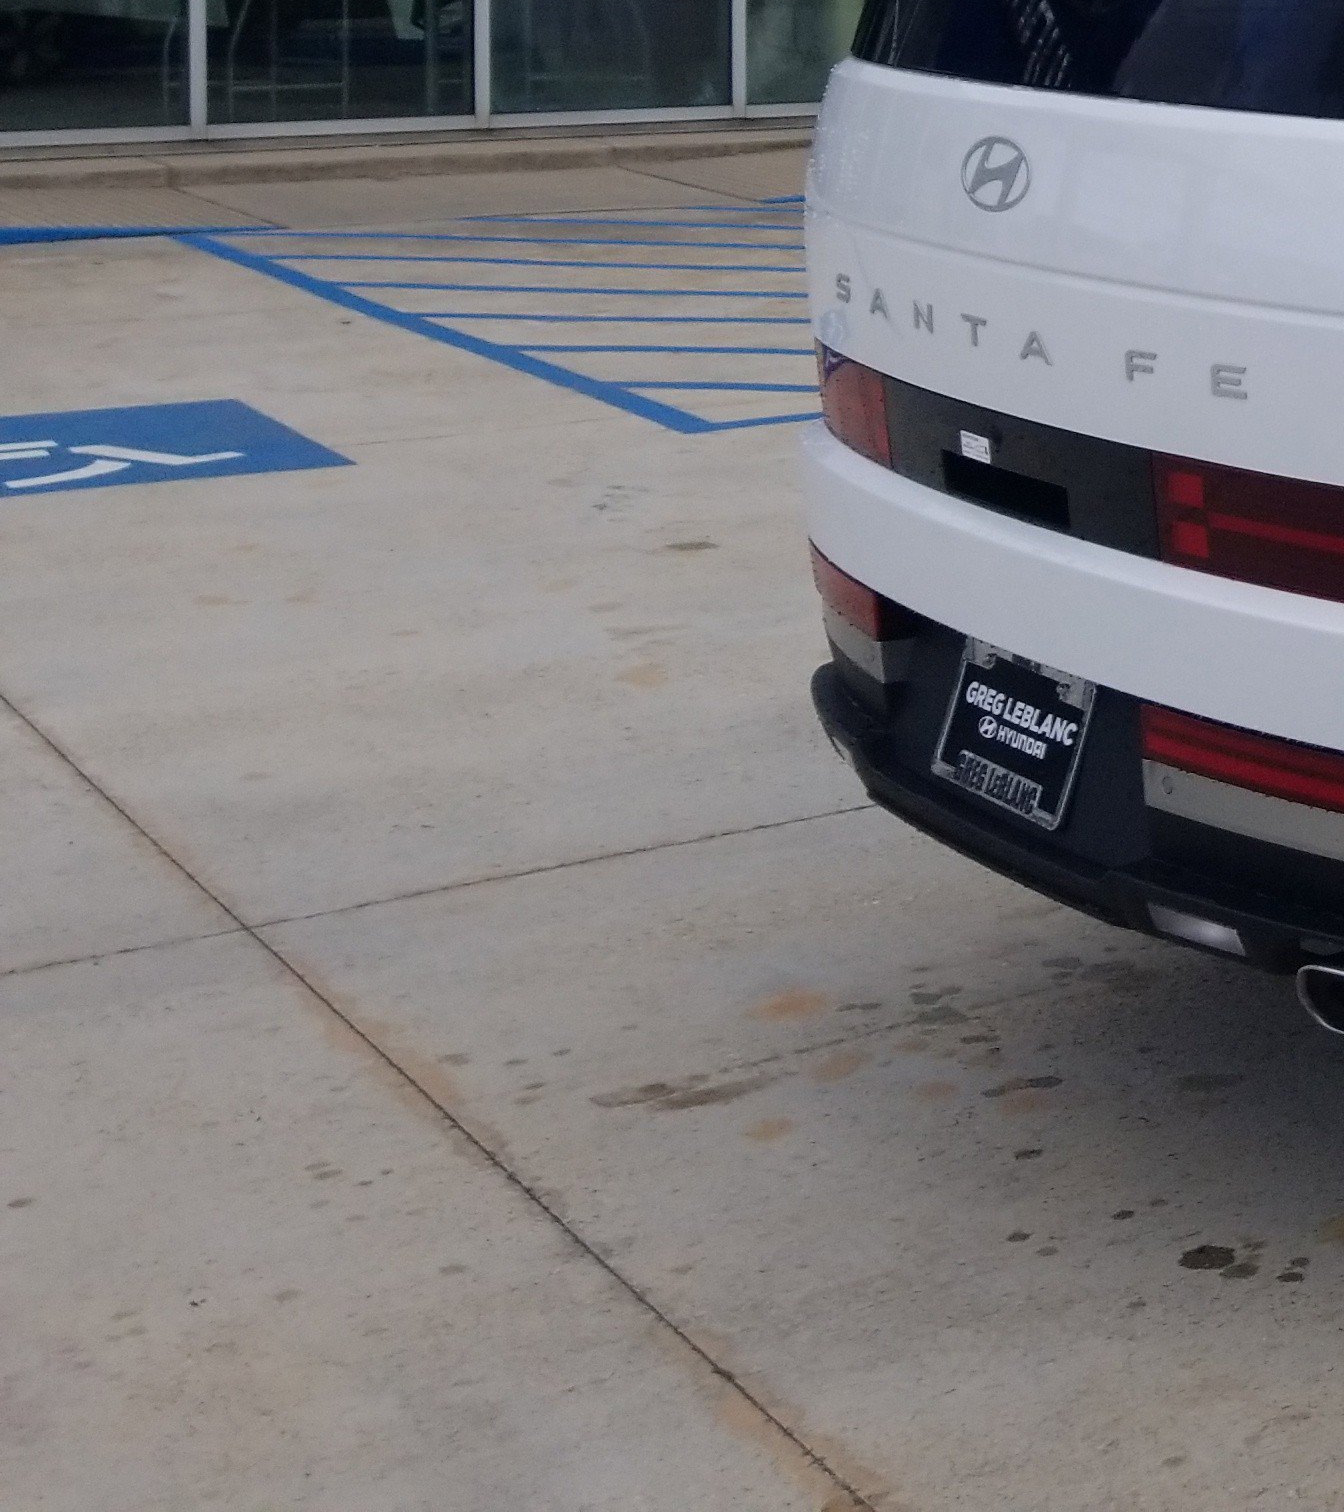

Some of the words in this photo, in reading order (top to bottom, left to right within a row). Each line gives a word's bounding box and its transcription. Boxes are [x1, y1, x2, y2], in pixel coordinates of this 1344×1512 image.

[834, 273, 1053, 367] SANTA
[1123, 349, 1249, 401] FE
[965, 681, 1006, 716] GREG
[1003, 698, 1078, 746] LEBLANC
[997, 725, 1047, 759] HYUNDAI
